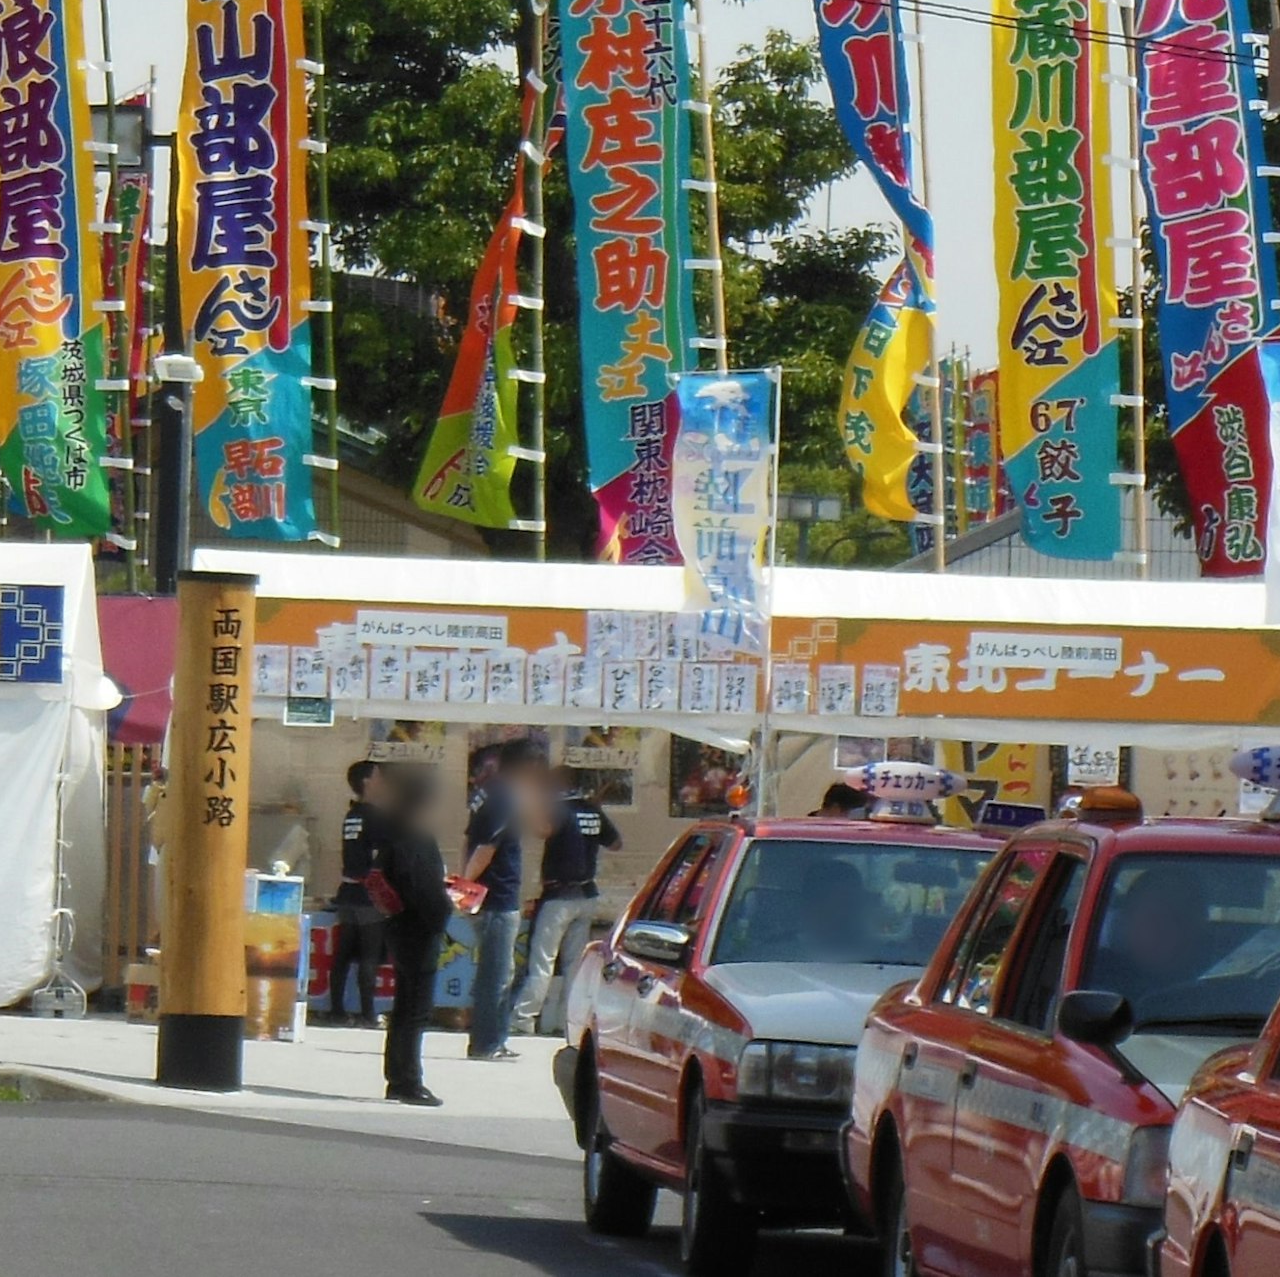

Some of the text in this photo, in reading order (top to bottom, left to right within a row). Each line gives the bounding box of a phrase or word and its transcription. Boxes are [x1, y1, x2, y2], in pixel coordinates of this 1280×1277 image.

[226, 368, 270, 427] 東京
[625, 401, 674, 566] 関東枕崎会
[1212, 404, 1264, 563] 渋谷康弘
[203, 607, 242, 827] 両国駅広小路
[880, 771, 936, 790] チェッカー
